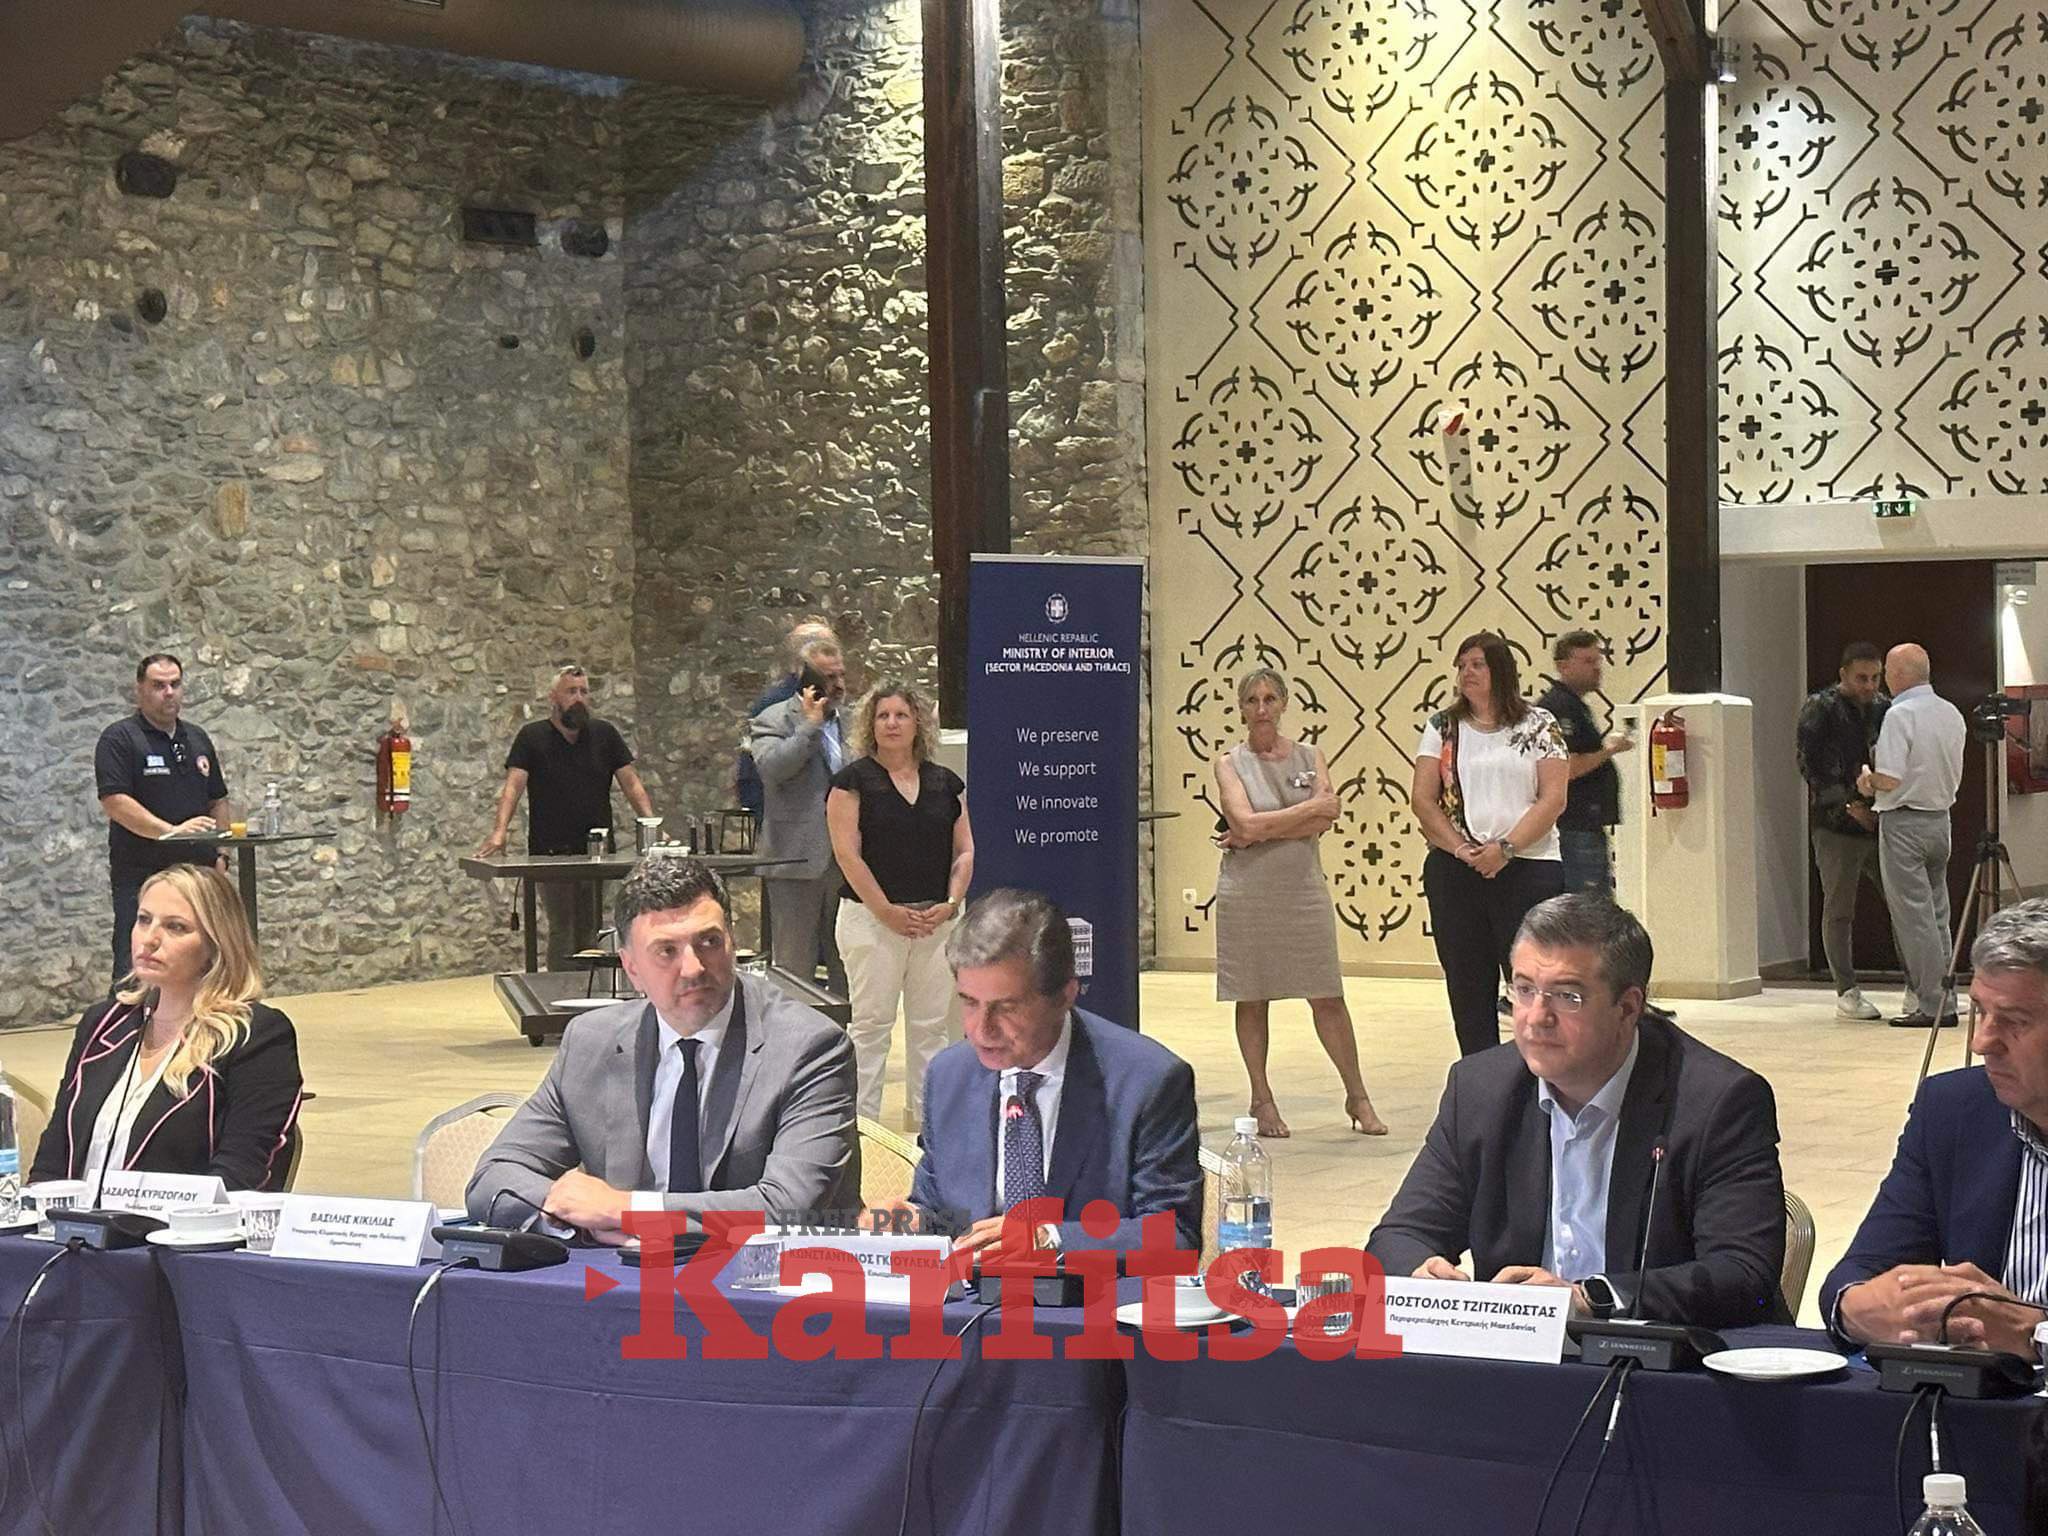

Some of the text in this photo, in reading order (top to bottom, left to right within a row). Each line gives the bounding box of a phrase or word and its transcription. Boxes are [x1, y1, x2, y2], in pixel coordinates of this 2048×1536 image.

[1018, 633, 1059, 643] HELLENIC
[1002, 647, 1115, 659] MINISTRY OF INTERIOR
[985, 662, 1131, 675] (SECTOR MACEDONIA AND THRACE)
[1016, 727, 1099, 747] We preserve
[1018, 760, 1097, 779] We support
[1016, 794, 1098, 811] We innovate
[1015, 828, 1099, 847] We promote
[310, 1212, 396, 1227] ΒΑΣΙΛΗΣ ΚΙΚΙΛΙΑΣ
[1376, 1294, 1558, 1318] ΑΠΟΣΤΟΛΟΣ ΤΖΙΤΖΙΚΩΣΤΑΣ
